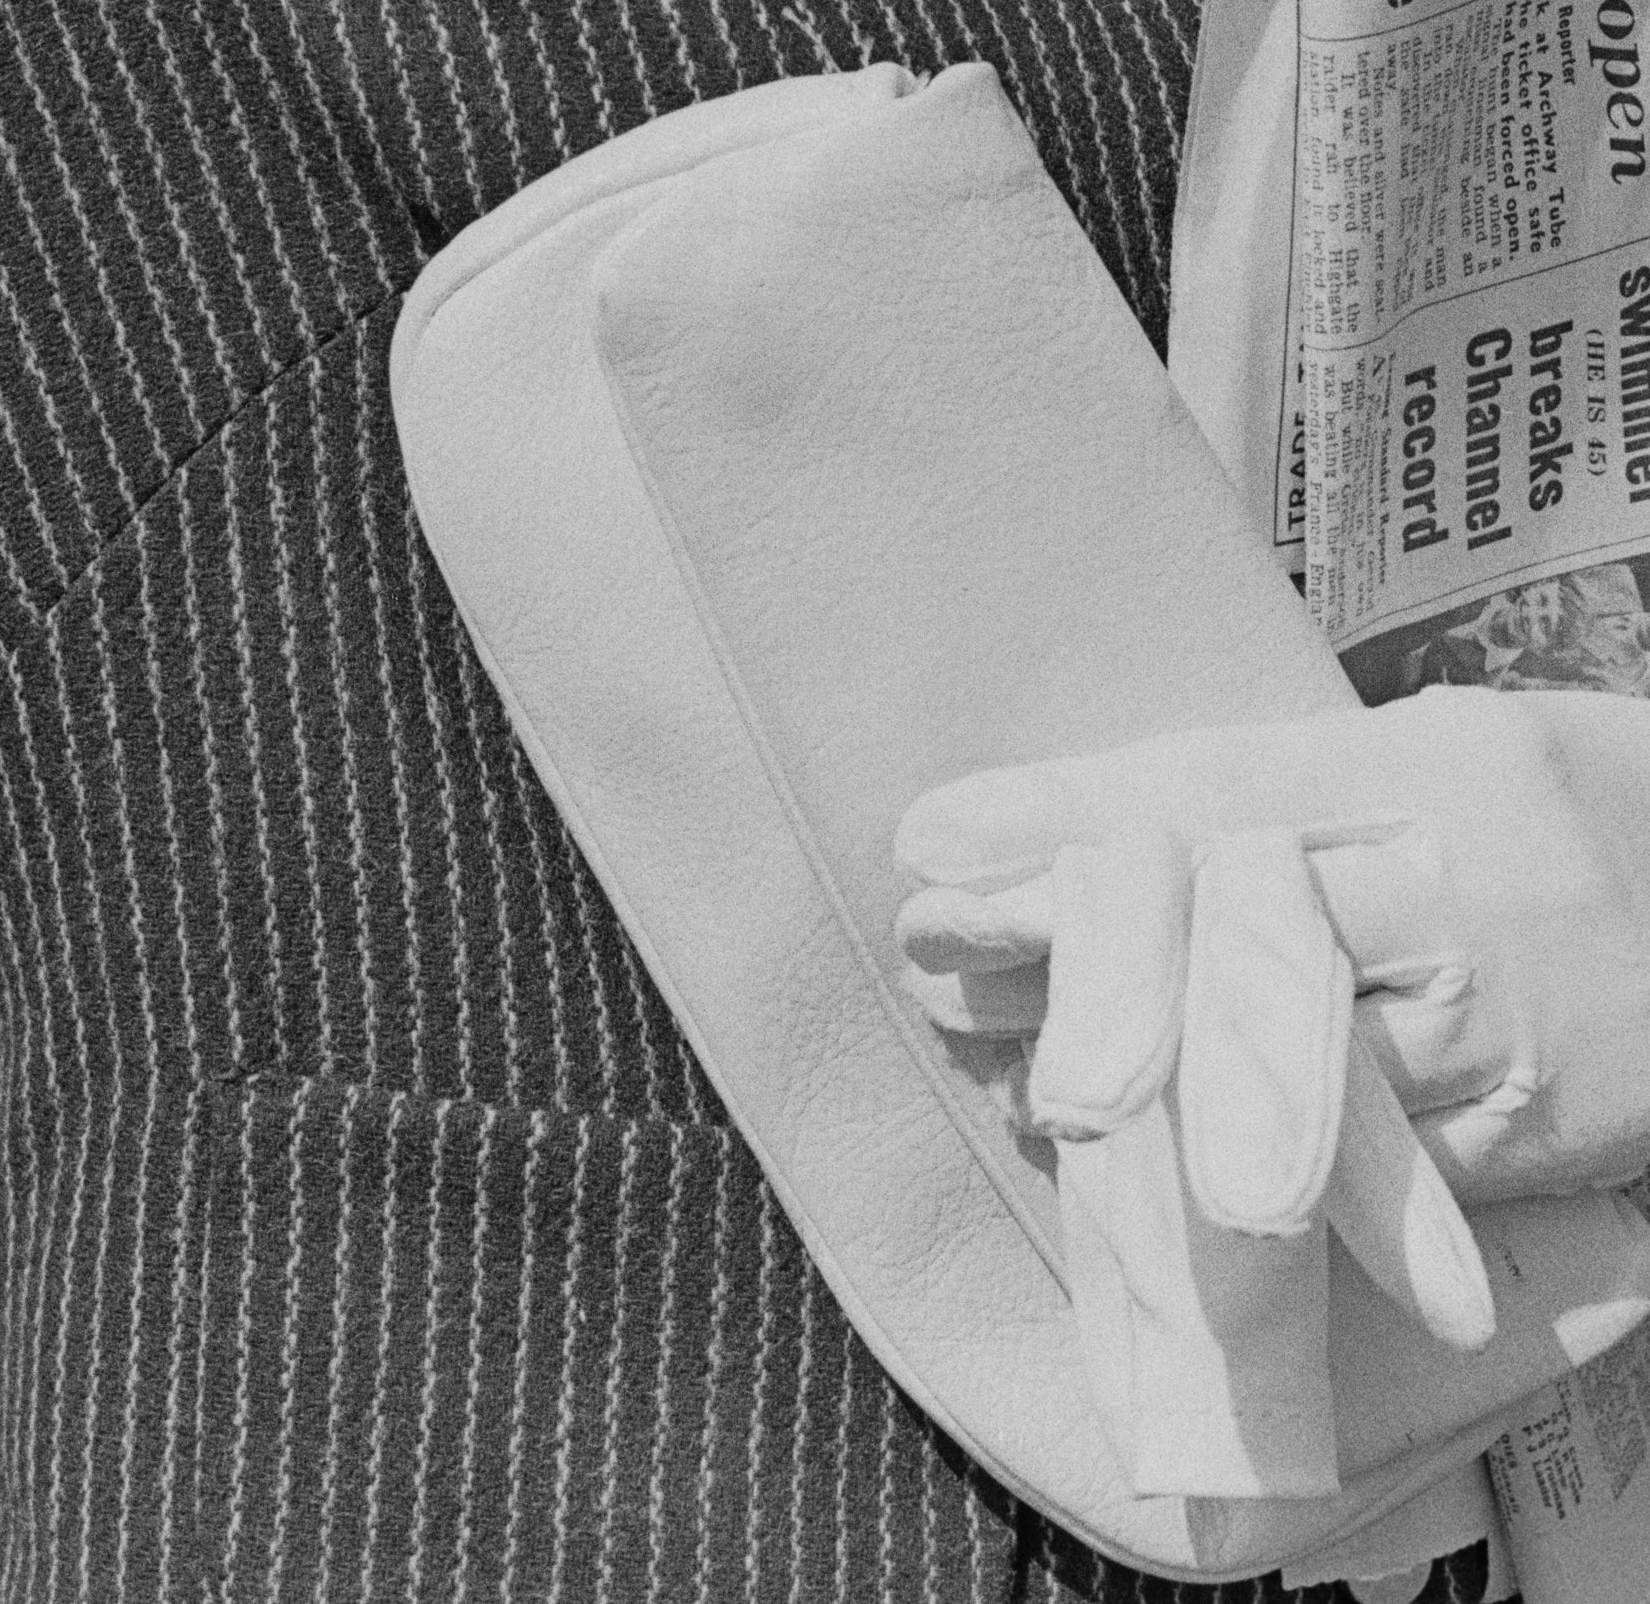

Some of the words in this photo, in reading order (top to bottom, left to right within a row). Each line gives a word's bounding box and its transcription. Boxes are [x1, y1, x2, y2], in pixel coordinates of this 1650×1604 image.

[1503, 2, 1517, 41] had
[1536, 33, 1548, 55] at
[1555, 5, 1576, 86] Reporter
[1323, 55, 1338, 114] raider
[1341, 72, 1356, 89] It
[1357, 51, 1371, 99] tered
[1373, 67, 1385, 118] Notes
[1411, 37, 1423, 132] discovered
[1486, 67, 1499, 112] hunt
[1500, 52, 1515, 105] been
[1518, 41, 1533, 109] ticket
[1342, 106, 1353, 142] was
[1358, 106, 1370, 146] over
[1374, 126, 1385, 162] and
[1537, 71, 1558, 174] Archway
[1311, 137, 1324, 191] found
[1360, 154, 1372, 185] the
[1484, 124, 1498, 183] began
[1500, 115, 1520, 188] forced
[1521, 124, 1539, 192] office
[1328, 204, 1341, 223] to
[1343, 157, 1358, 232] believed
[1360, 192, 1373, 240] floor.
[1375, 171, 1387, 220] silver
[1460, 176, 1473, 237] beside
[1473, 185, 1487, 244] found
[1548, 188, 1566, 249] Tube
[1487, 194, 1502, 248] when
[1504, 198, 1521, 262] open.
[1528, 207, 1546, 253] safe
[1314, 230, 1327, 288] locked
[1345, 249, 1359, 287] that
[1375, 230, 1385, 271] were
[1424, 257, 1436, 291] and
[1435, 247, 1448, 288] man
[1462, 252, 1474, 278] an
[1477, 262, 1487, 273] a
[1492, 258, 1501, 268] a
[1326, 249, 1345, 335] Highgate
[1314, 300, 1327, 336] and
[1346, 302, 1359, 333] the
[1586, 328, 1606, 381] (HE
[1324, 365, 1337, 399] was
[1341, 380, 1354, 414] But
[1308, 362, 1323, 465] yesterday's
[1528, 319, 1574, 512] breaks
[1586, 396, 1606, 423] IS
[1324, 411, 1339, 478] beating
[1341, 425, 1354, 473] while
[1402, 364, 1449, 553] record
[1465, 327, 1514, 551] Channel
[1586, 437, 1607, 478] 45)
[1379, 428, 1391, 504] Standard
[1326, 492, 1340, 514] all
[1327, 527, 1340, 555] the
[1309, 563, 1325, 626] Engla
